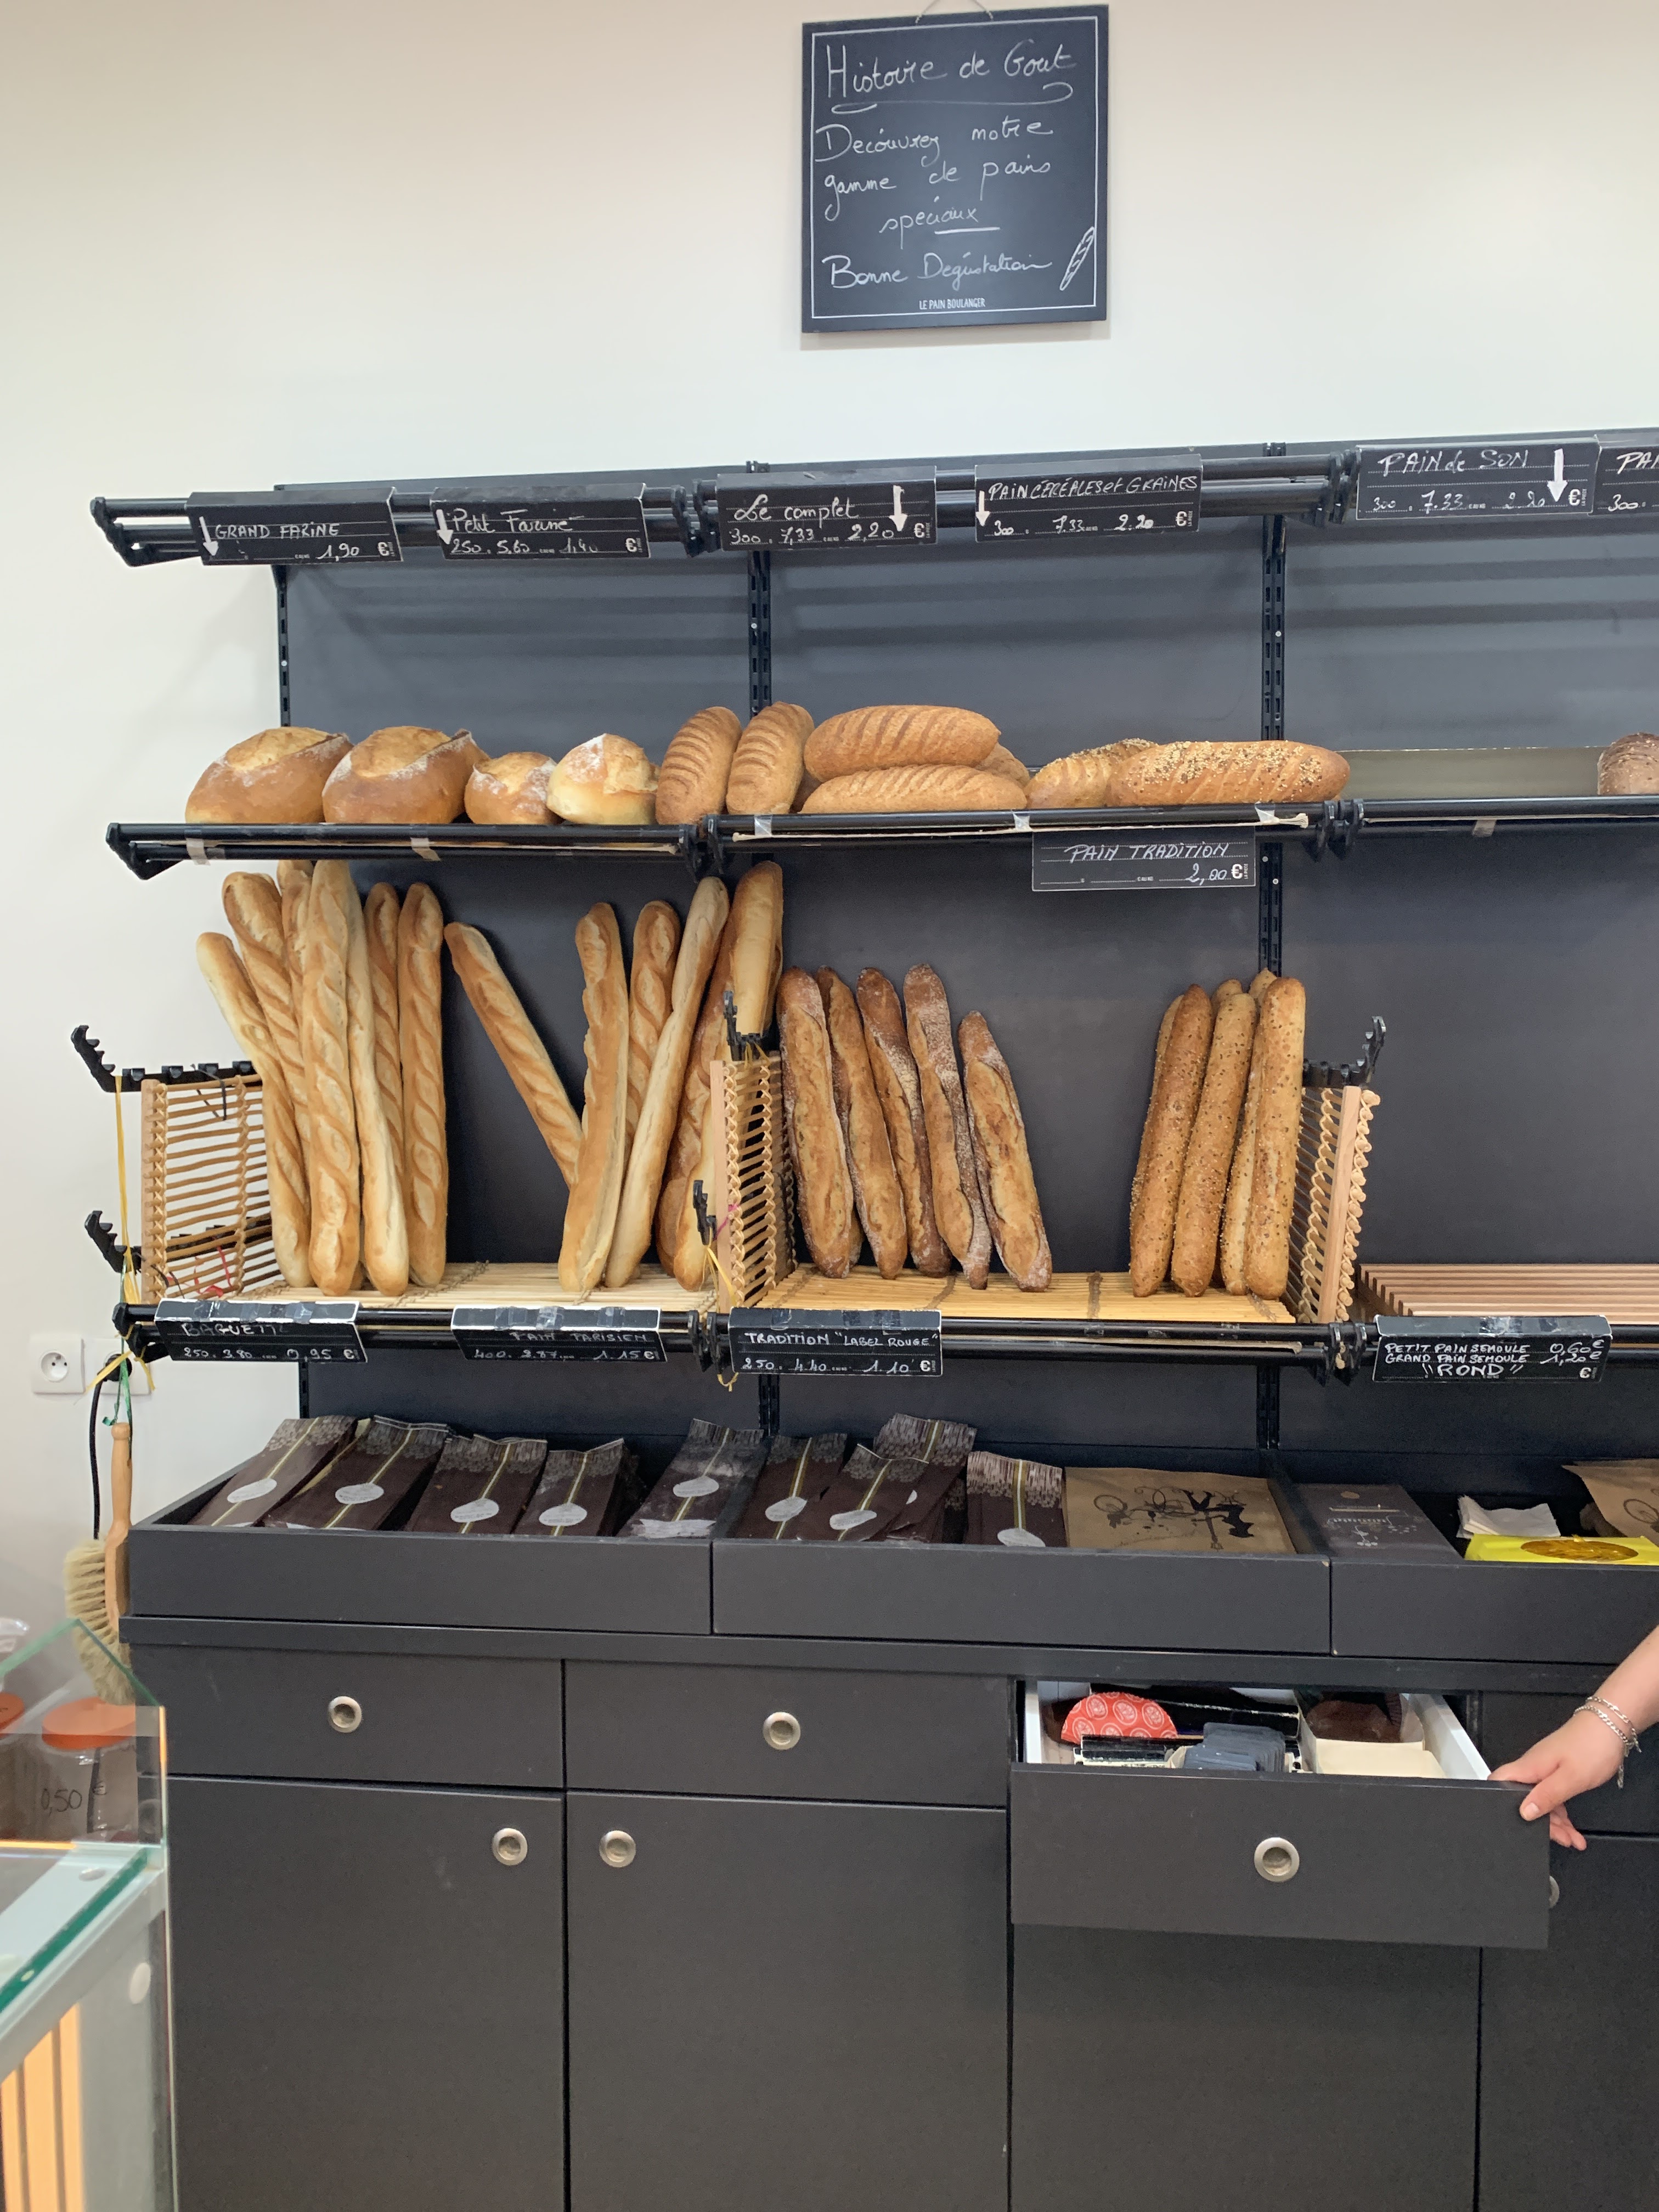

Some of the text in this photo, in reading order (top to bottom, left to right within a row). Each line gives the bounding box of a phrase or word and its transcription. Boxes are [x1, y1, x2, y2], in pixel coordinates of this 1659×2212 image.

[826, 44, 948, 99] Histoire
[958, 52, 990, 78] de
[824, 154, 1051, 221] gamme de pains
[822, 255, 909, 289] Bonne
[919, 297, 986, 310] LE PAIN BOULANGER
[1444, 449, 1465, 473] de
[1480, 449, 1529, 469] SON
[1373, 496, 1397, 511] 300
[1568, 489, 1581, 506] €
[1607, 494, 1639, 512] 300
[733, 493, 860, 528] Le complet
[215, 524, 270, 539] GRAND
[994, 520, 1015, 535] 300
[1175, 511, 1187, 527] €
[729, 528, 761, 545] 300
[848, 522, 894, 542] 2,20
[913, 522, 926, 538] €
[316, 543, 360, 562] 1,90
[377, 541, 389, 556] €
[450, 538, 482, 553] 250
[625, 538, 637, 552] €
[1184, 863, 1243, 885] 2,00 €
[184, 1347, 208, 1358] 250
[343, 1349, 356, 1358] €
[474, 1349, 506, 1358] 400
[1384, 1343, 1429, 1353] PETIT
[1470, 1344, 1531, 1354] SEMOULE
[742, 1357, 775, 1370] 250
[919, 1361, 931, 1372] €
[1385, 1353, 1431, 1364] GRAND
[1469, 1353, 1529, 1363] SEMOULE
[1579, 1367, 1592, 1379] €
